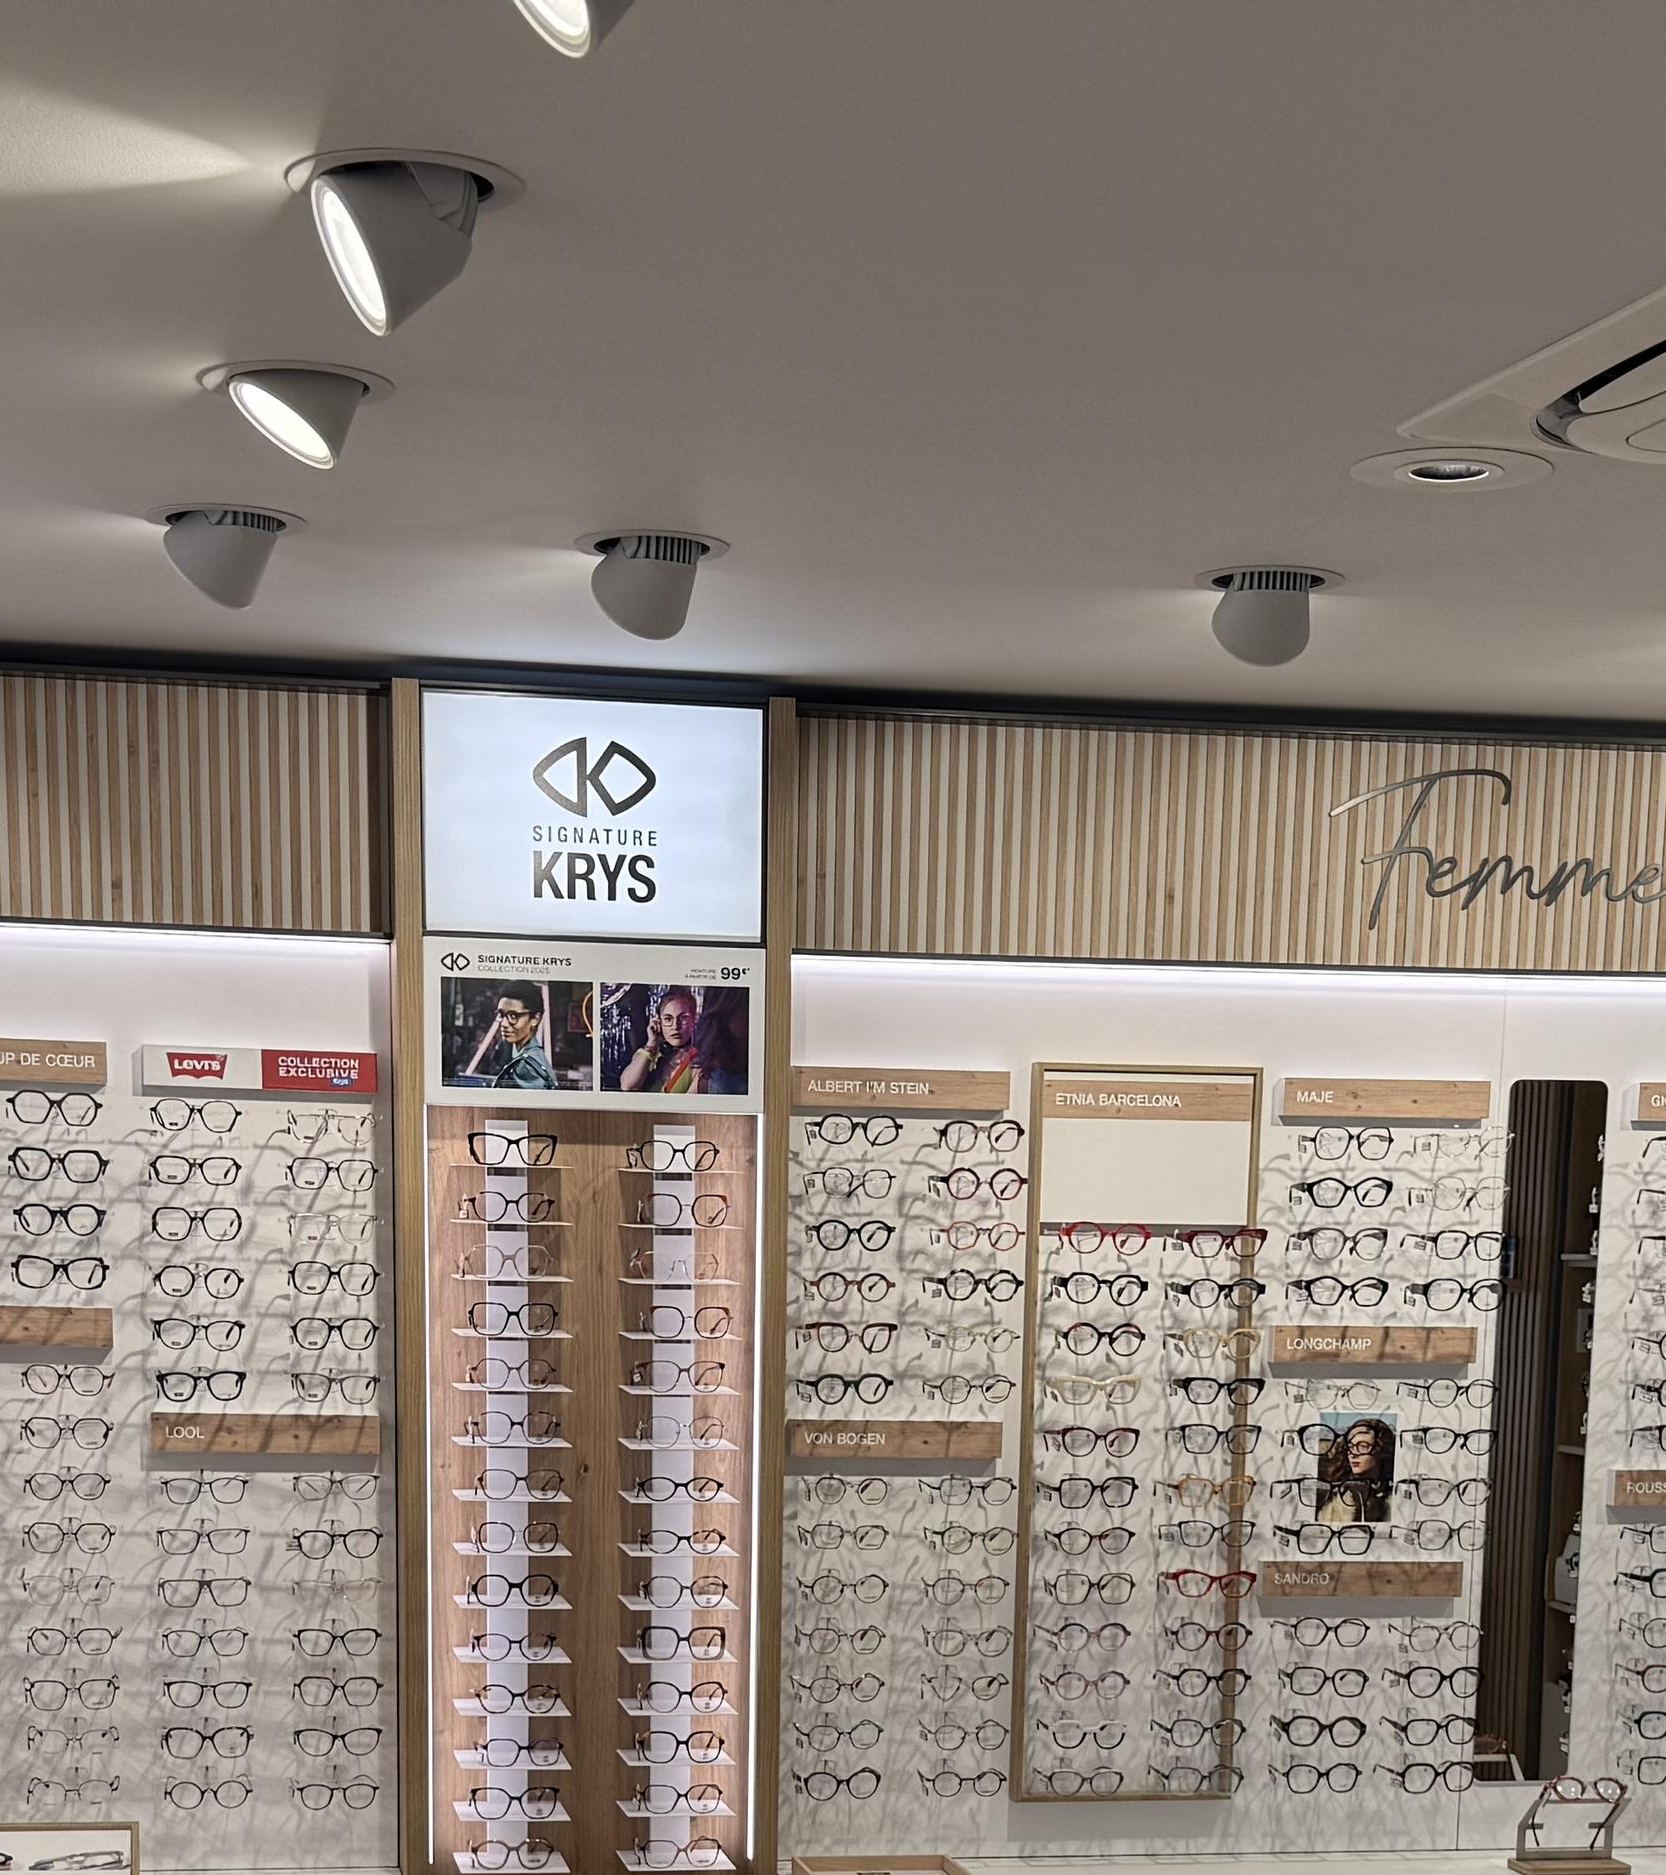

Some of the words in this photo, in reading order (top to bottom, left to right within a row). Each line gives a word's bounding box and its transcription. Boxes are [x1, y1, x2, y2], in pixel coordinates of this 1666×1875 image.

[533, 825, 657, 847] SIGNATURE
[533, 850, 657, 904] KRYS
[477, 954, 540, 966] SIGNATURE
[542, 957, 572, 967] KRYS
[20, 1053, 41, 1066] DE
[45, 1054, 96, 1068] CŒUR
[278, 1056, 359, 1069] COLLECTION
[807, 1079, 862, 1093] ALBERT
[866, 1081, 885, 1094] I'M
[890, 1081, 930, 1095] STEIN
[1055, 1092, 1095, 1106] ETNIA
[1099, 1093, 1182, 1108] BARCELONA
[1296, 1090, 1334, 1103] MAJE
[1286, 1337, 1372, 1351] LONGCHAMP
[165, 1425, 205, 1439] LOOL
[804, 1431, 833, 1445] VON
[836, 1432, 886, 1445] BOGEN
[1274, 1572, 1330, 1585] SANDRO
